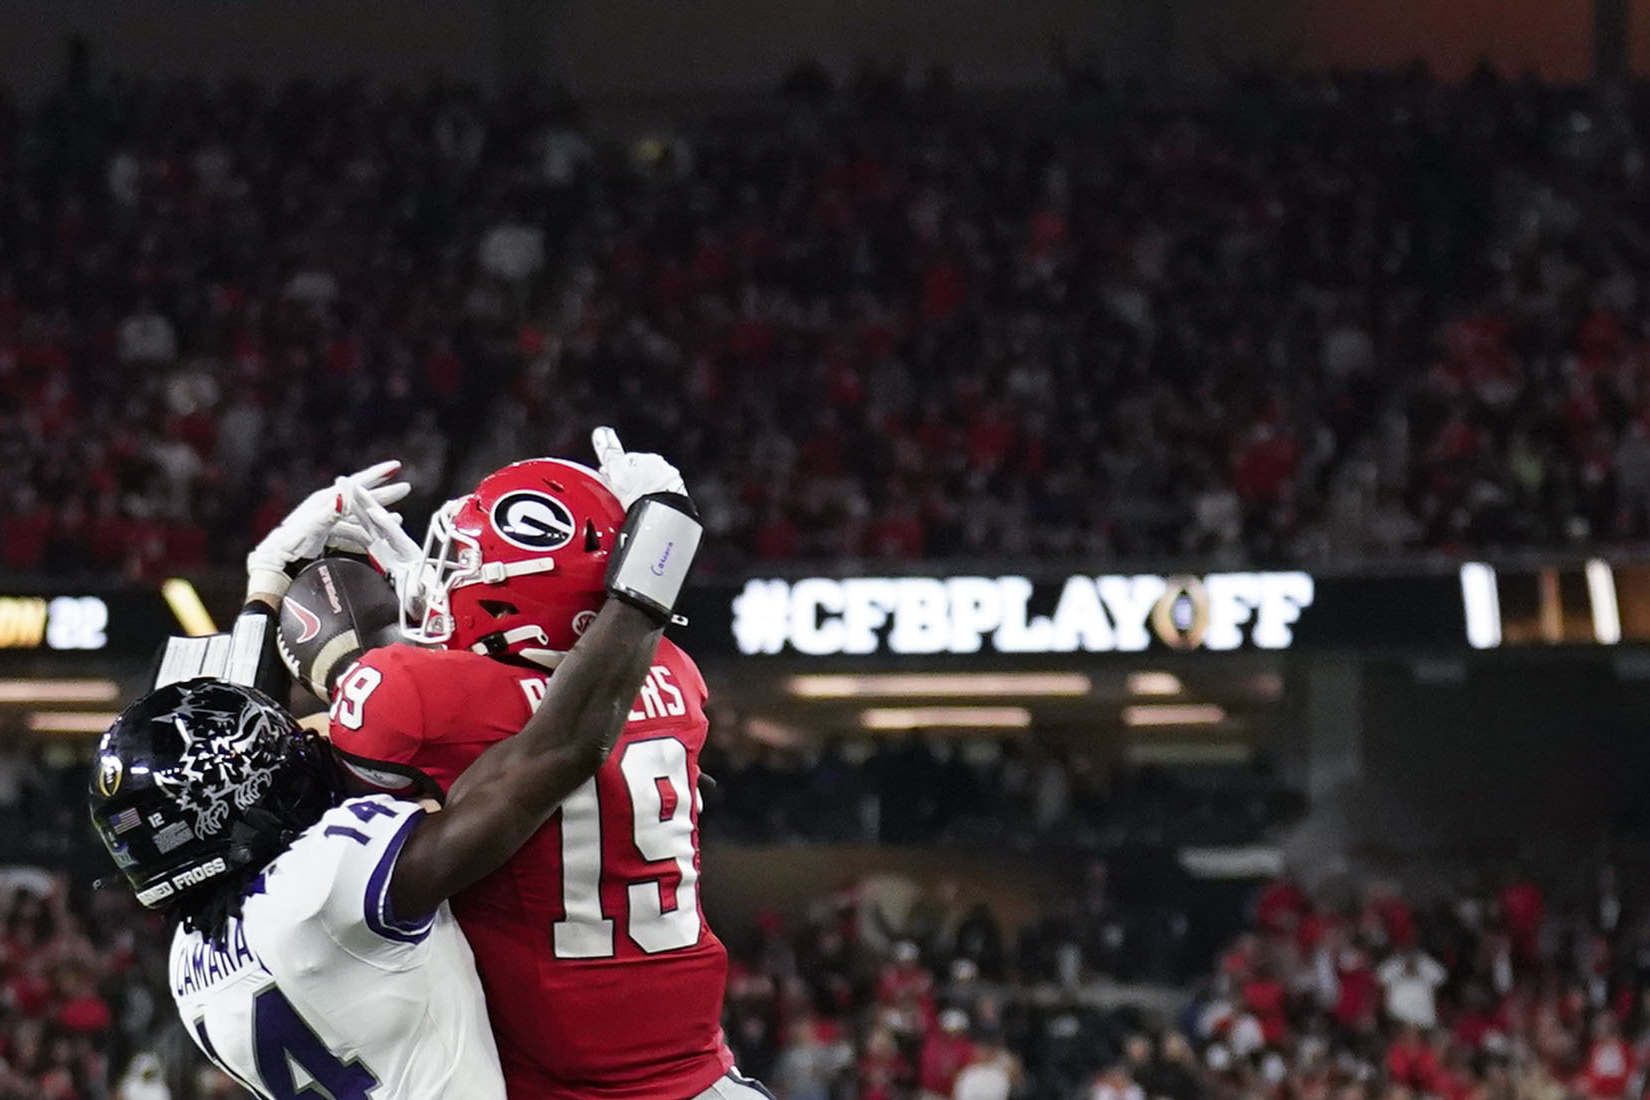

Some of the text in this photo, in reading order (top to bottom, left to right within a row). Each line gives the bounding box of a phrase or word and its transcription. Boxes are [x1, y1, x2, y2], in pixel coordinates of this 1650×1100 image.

[48, 597, 108, 649] 22
[731, 571, 1314, 654] #CFBPLAYOFF
[148, 812, 165, 828] 12
[324, 800, 399, 846] 14
[552, 736, 702, 958] 19
[172, 857, 226, 890] FROGS
